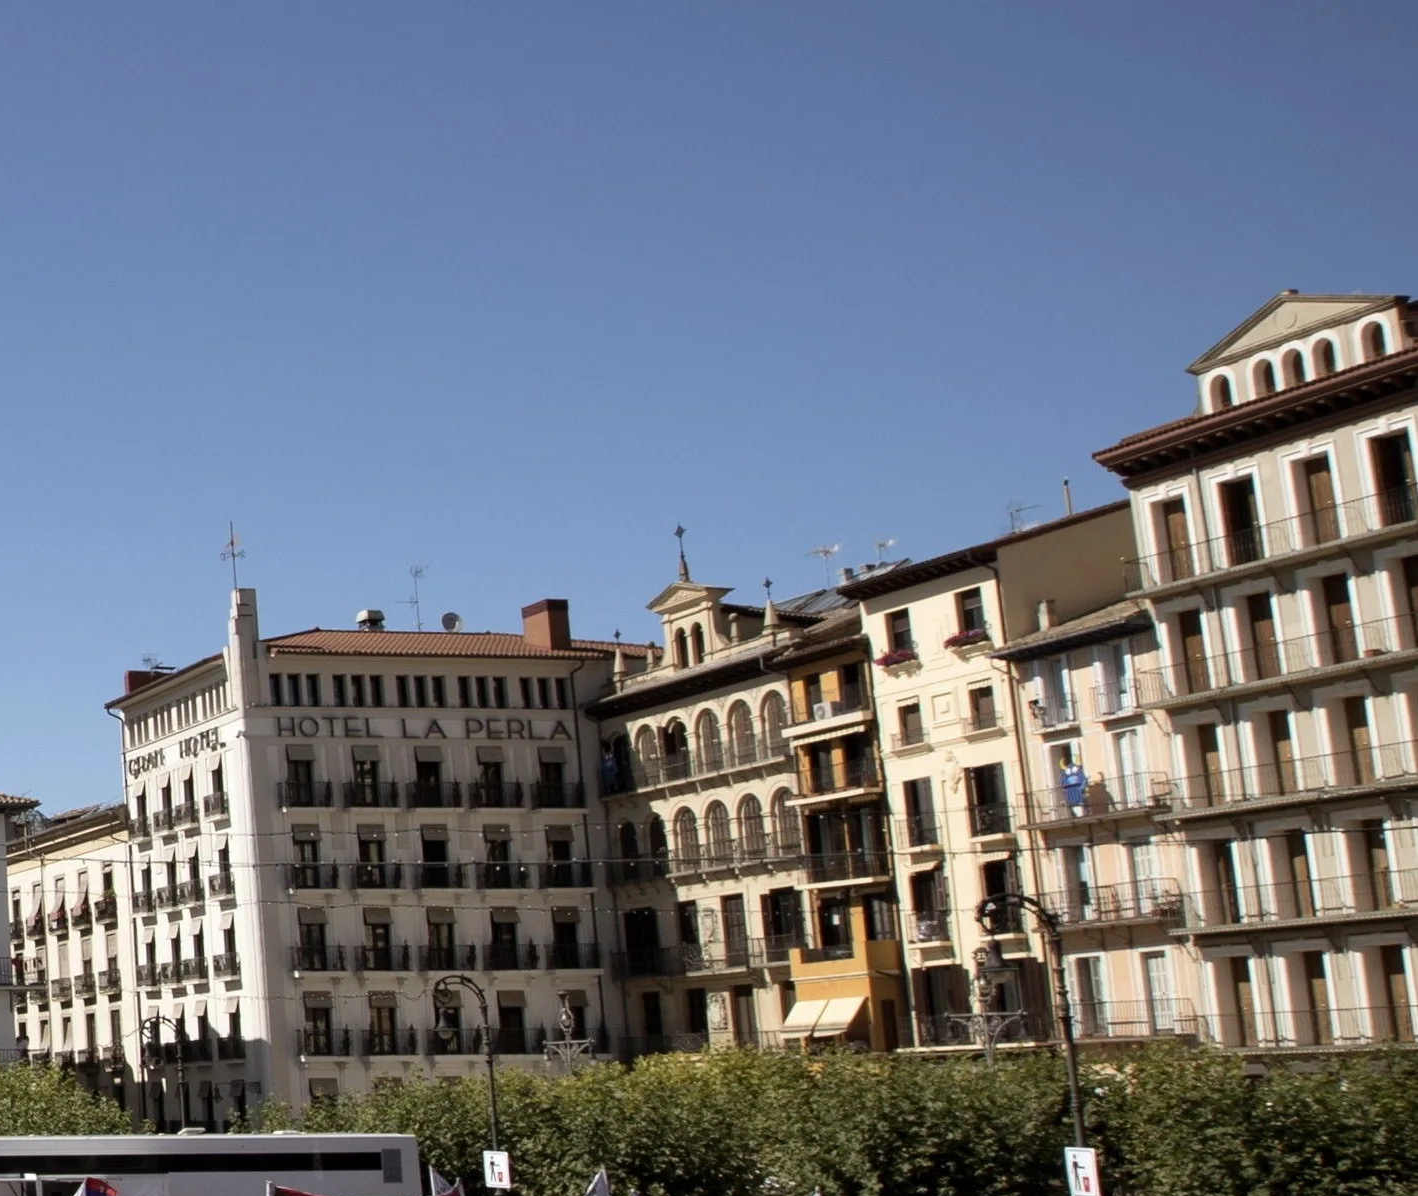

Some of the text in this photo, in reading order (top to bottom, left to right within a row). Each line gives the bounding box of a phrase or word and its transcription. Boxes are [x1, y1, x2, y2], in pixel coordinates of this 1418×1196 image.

[179, 727, 227, 758] HOTEL
[277, 717, 574, 741] HOTEL LA PERLA
